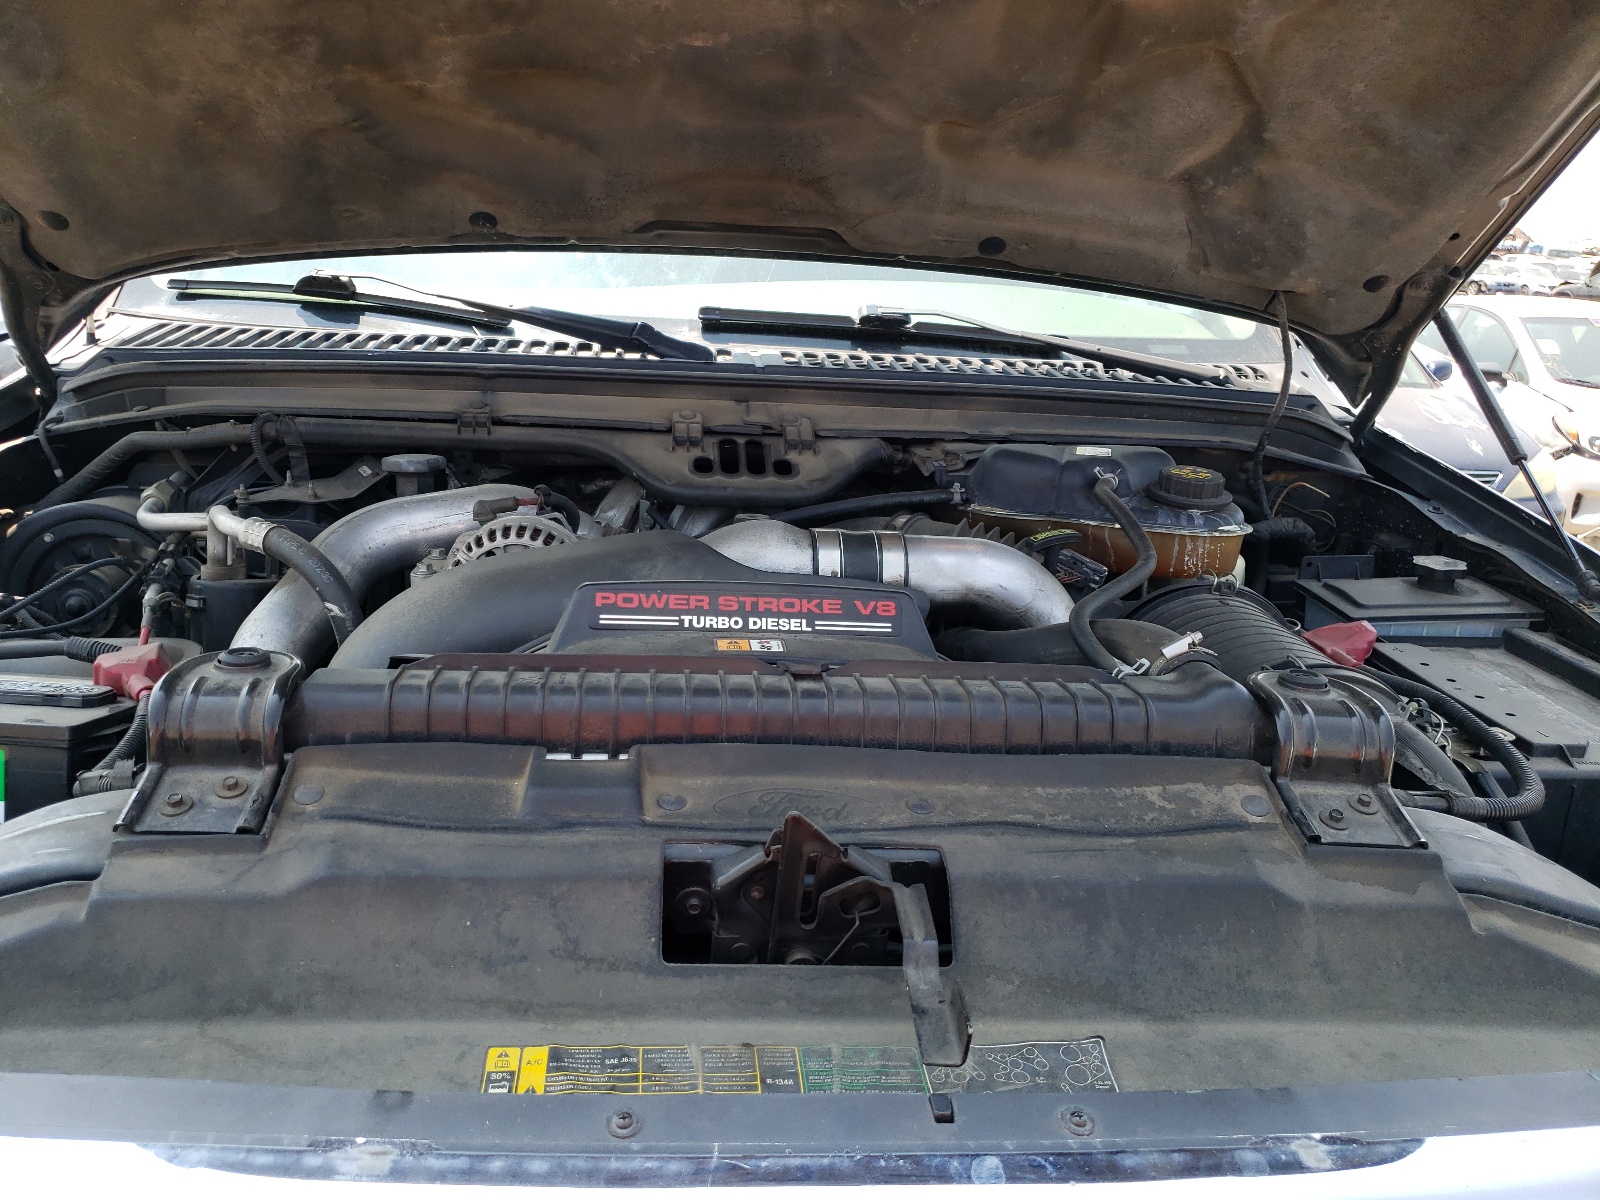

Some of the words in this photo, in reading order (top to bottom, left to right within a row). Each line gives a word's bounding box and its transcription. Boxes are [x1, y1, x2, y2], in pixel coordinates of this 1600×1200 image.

[280, 535, 301, 550] TYPE
[595, 592, 710, 610] POWER
[718, 595, 842, 614] STROKE
[854, 600, 896, 616] V8
[681, 616, 743, 630] TURBO
[749, 617, 812, 631] DIESEL
[605, 1057, 619, 1065] SAE
[490, 1072, 511, 1080] 50%
